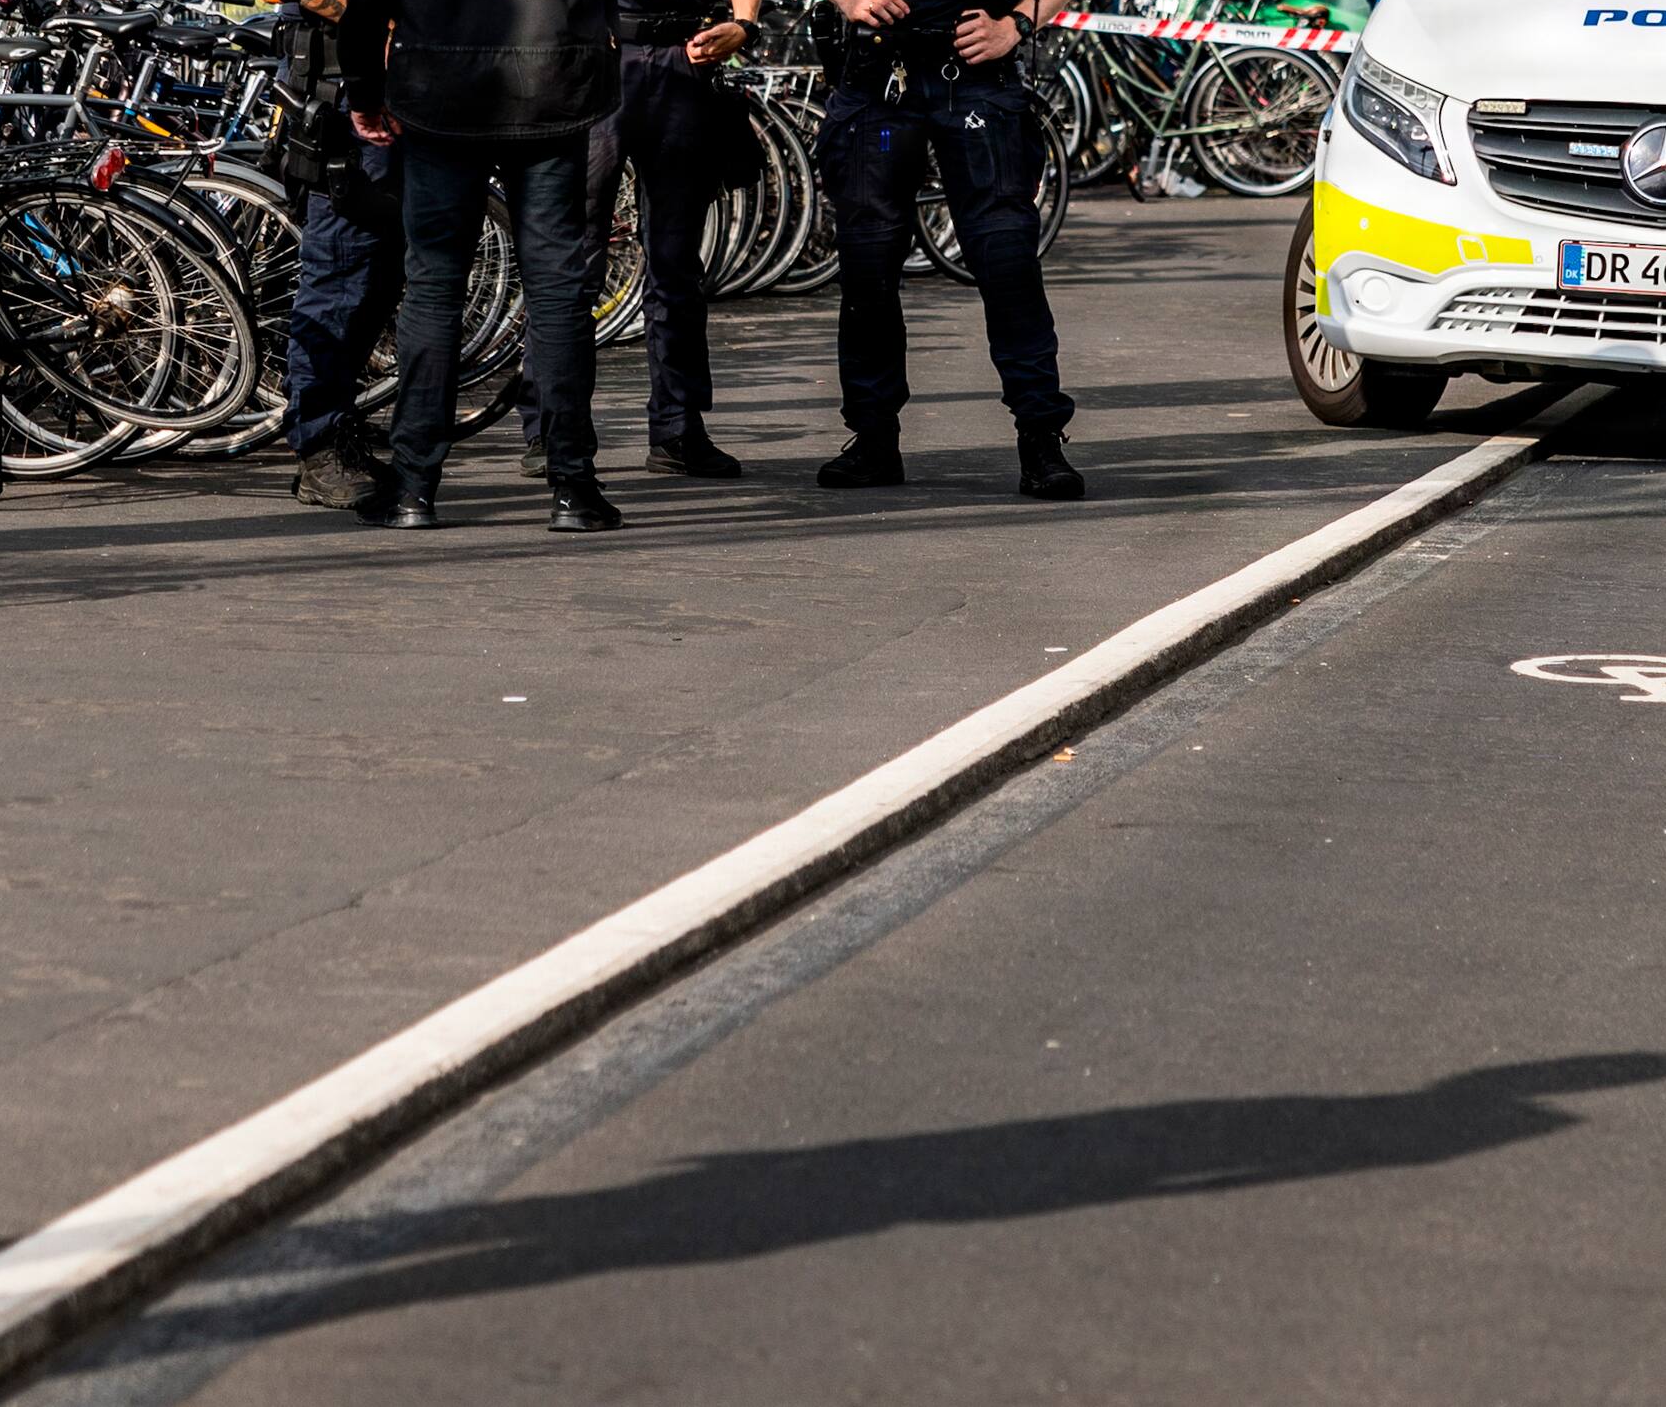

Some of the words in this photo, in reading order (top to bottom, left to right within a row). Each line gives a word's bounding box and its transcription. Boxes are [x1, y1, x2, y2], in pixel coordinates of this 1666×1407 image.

[1236, 29, 1271, 39] POLITI
[1565, 268, 1579, 280] DK
[1585, 251, 1631, 284] DR
